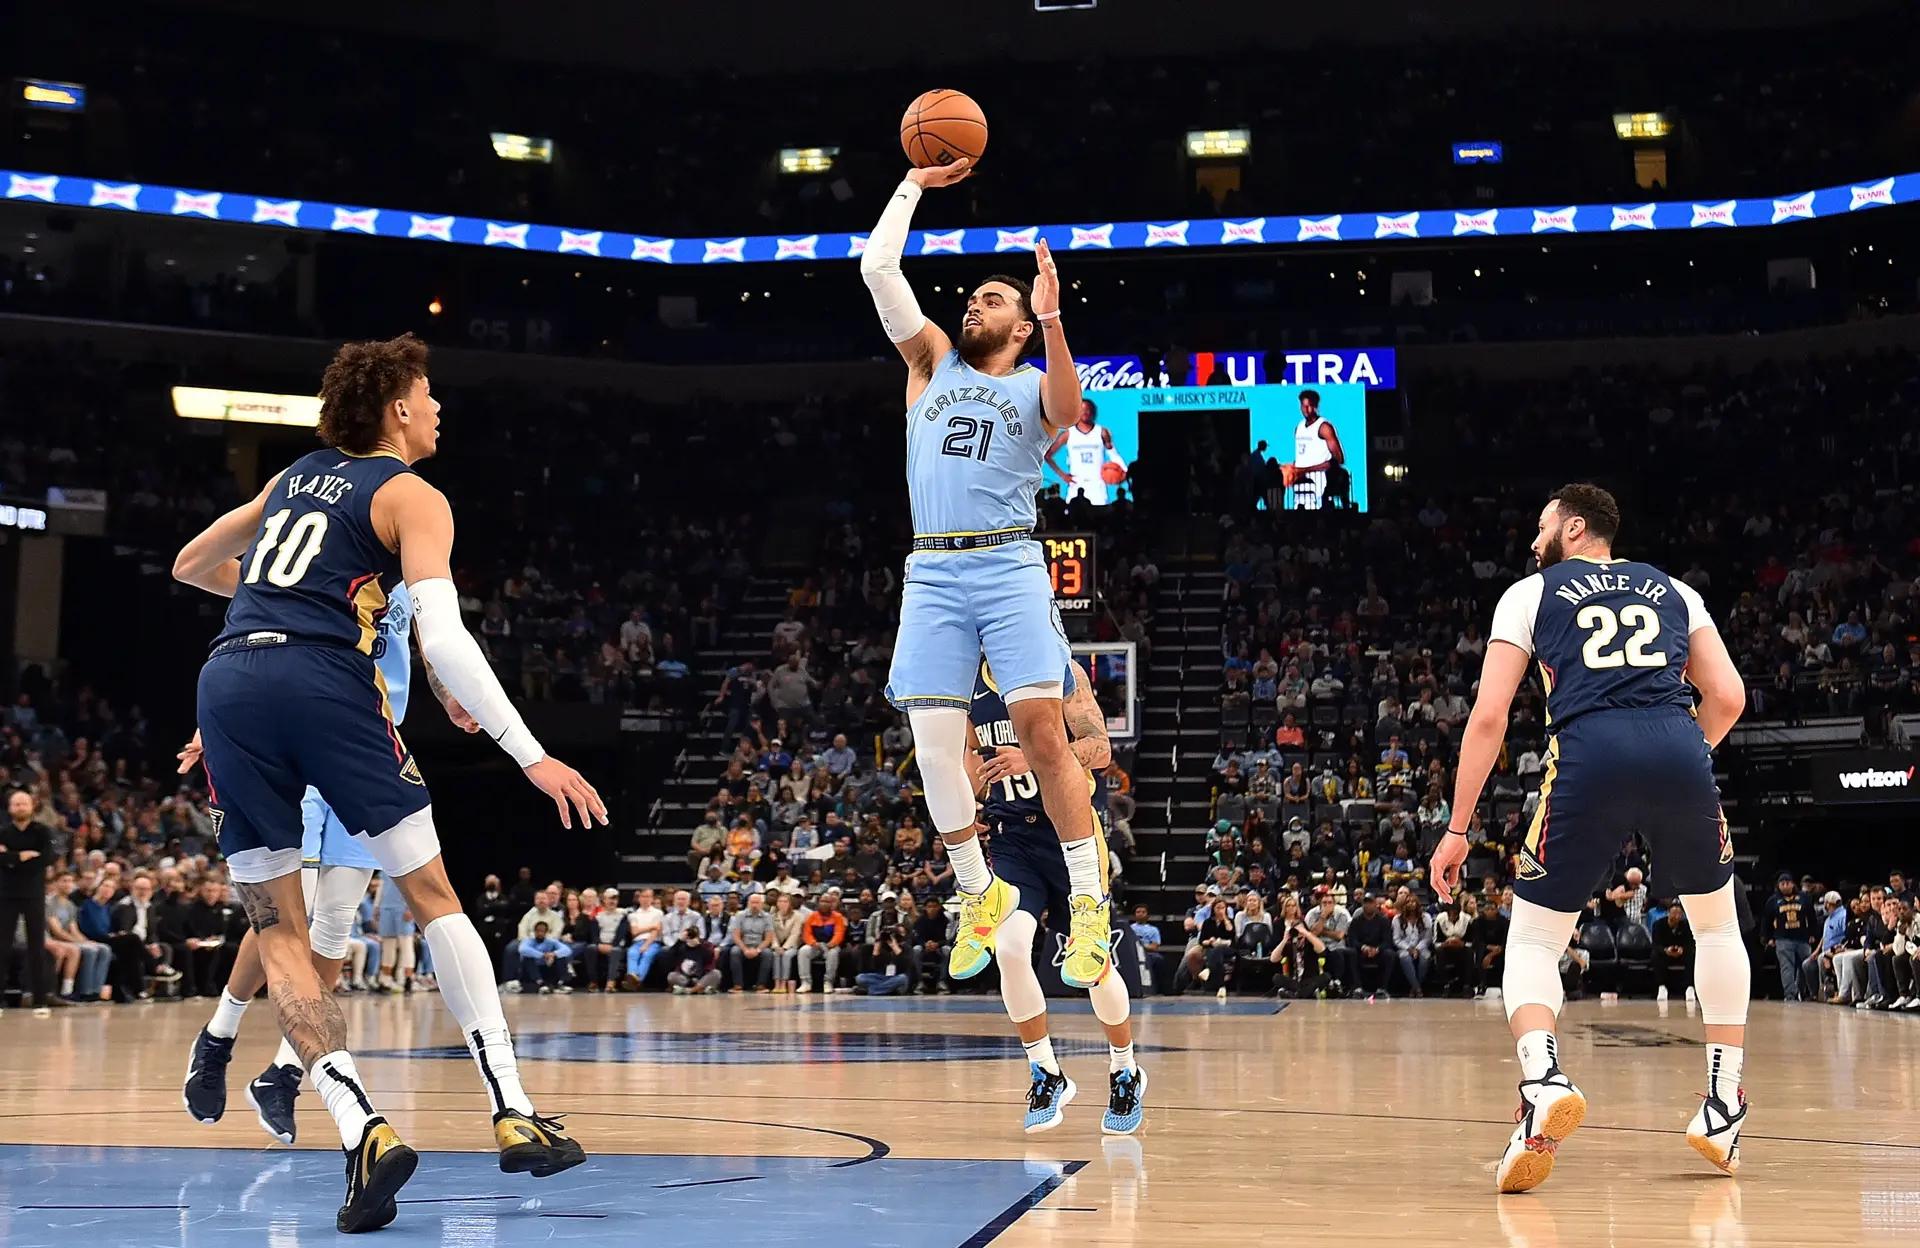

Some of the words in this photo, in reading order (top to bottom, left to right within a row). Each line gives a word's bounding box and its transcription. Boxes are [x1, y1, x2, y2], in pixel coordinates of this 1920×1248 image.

[1227, 352, 1379, 388] UTRA
[924, 386, 1022, 436] GRIZZLIES
[1141, 393, 1165, 406] SLIM
[1174, 391, 1216, 405] HUSKY'S
[1218, 390, 1246, 404] PIZZA
[940, 415, 995, 462] 21
[286, 473, 353, 505] HAYES
[243, 508, 330, 588] 10
[1045, 538, 1087, 559] 7:47
[1050, 558, 1083, 595] 13
[1555, 573, 1631, 606] NANCE
[1058, 598, 1091, 610] SSOT
[1576, 604, 1668, 669] 22
[1838, 767, 1908, 788] verizon
